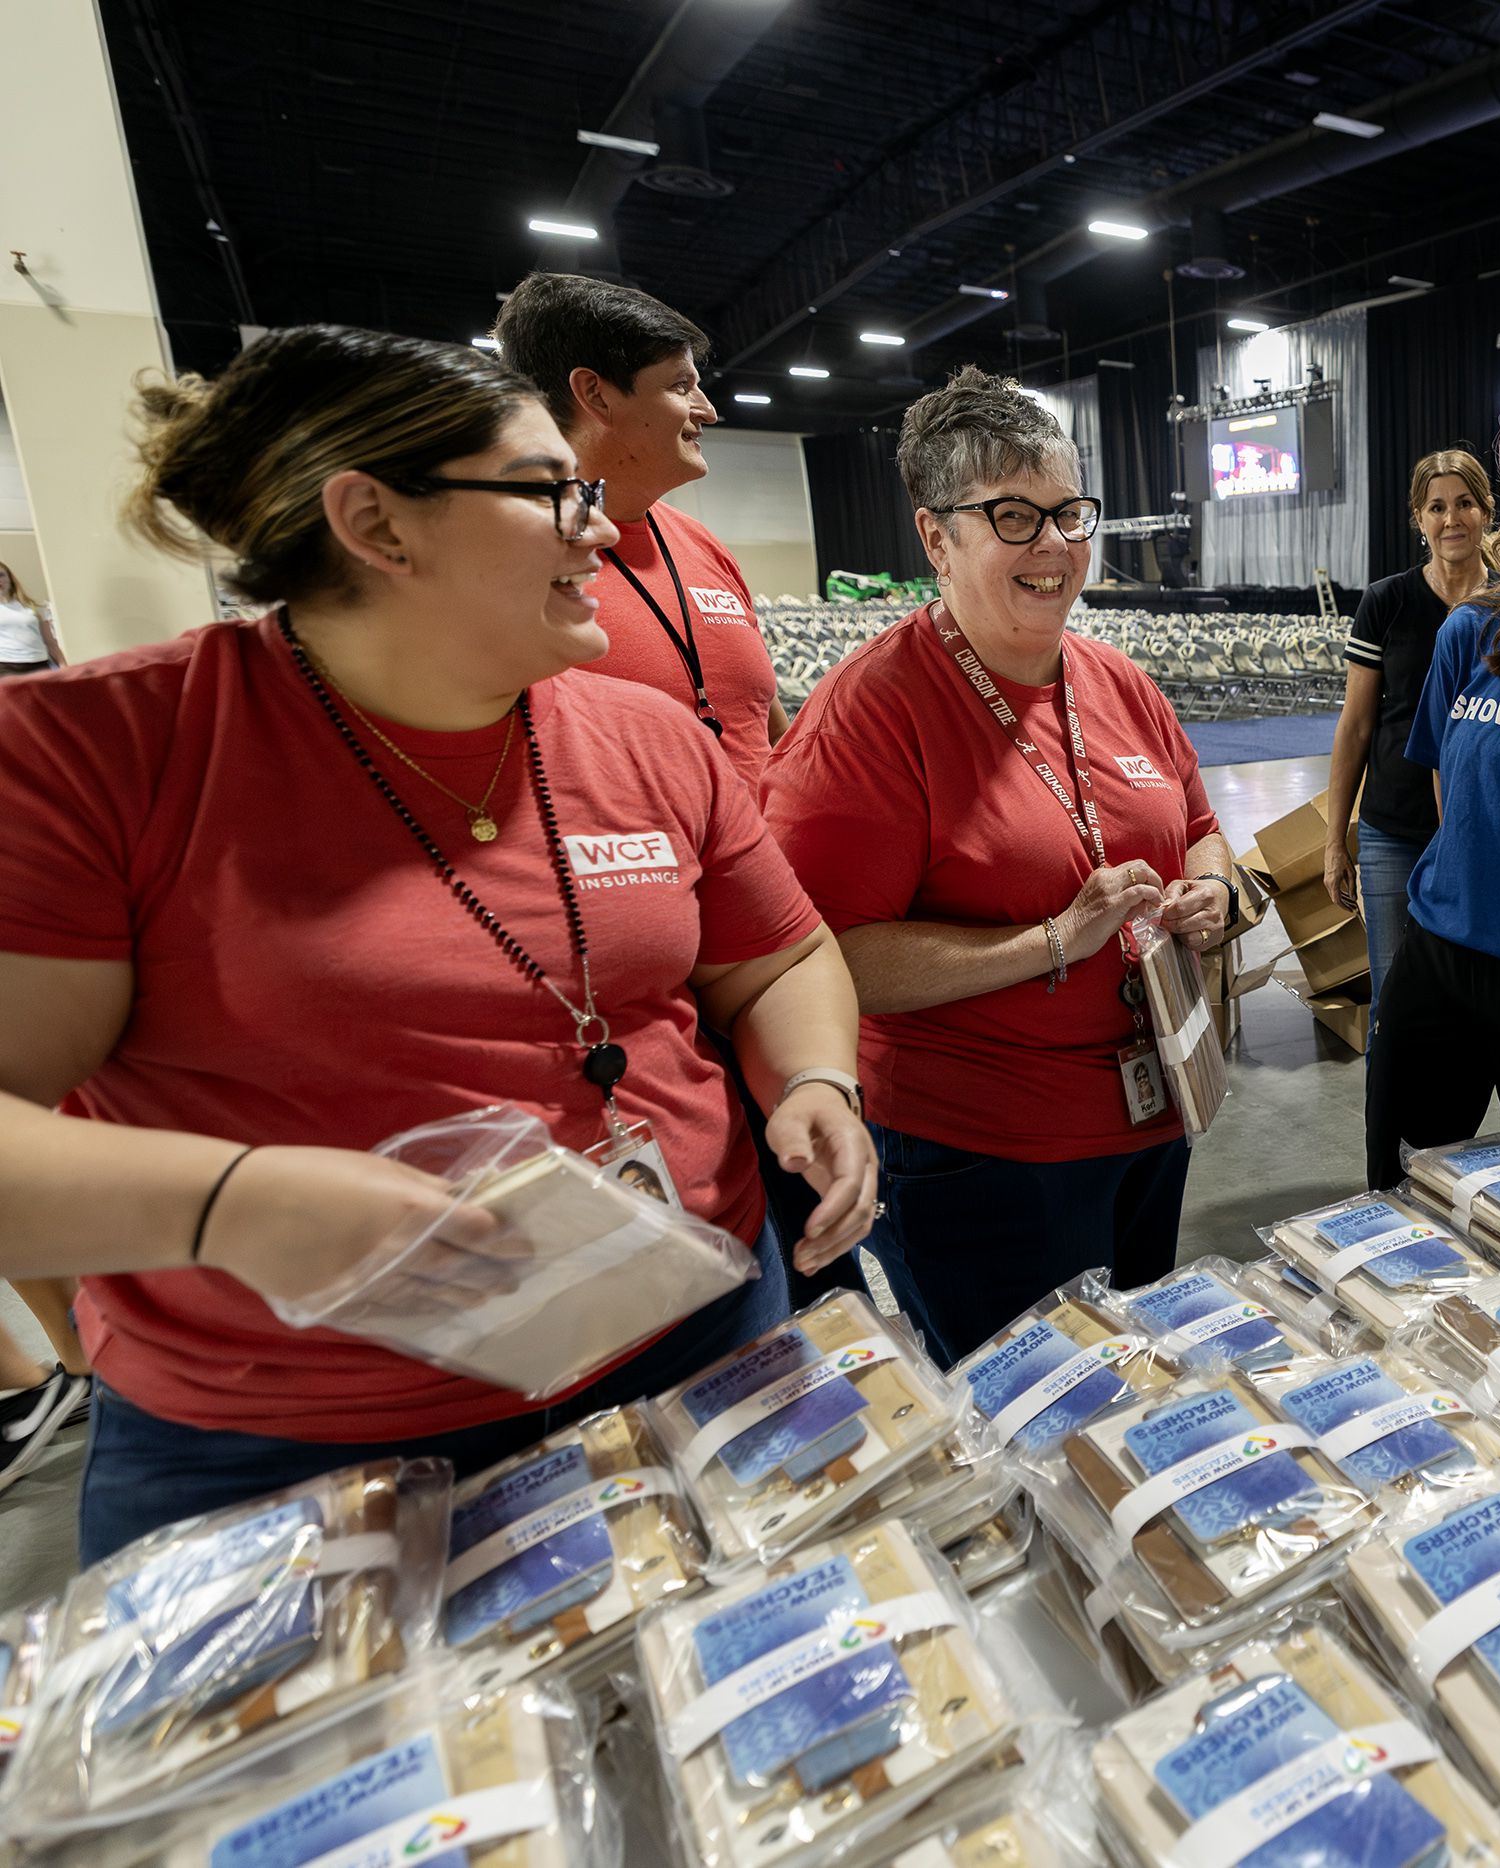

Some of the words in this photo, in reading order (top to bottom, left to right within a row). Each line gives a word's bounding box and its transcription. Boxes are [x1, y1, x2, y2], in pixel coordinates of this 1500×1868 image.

[696, 592, 736, 610] WCF
[703, 616, 751, 628] INSURANC
[955, 648, 998, 699] CRIMSON
[990, 697, 1018, 727] TIDE
[1065, 681, 1077, 709] TIDE
[1069, 711, 1086, 758] CRIMSON
[1036, 763, 1073, 810] CRIMSON
[1083, 799, 1099, 825] TIDE
[577, 838, 661, 866] WCF
[579, 872, 680, 891] INSURANCE
[1324, 1205, 1389, 1229] TEACHERS
[1353, 1219, 1368, 1228] UP
[1367, 1210, 1394, 1222] SHOW
[1364, 1235, 1408, 1253] TEACHERS
[1382, 1244, 1393, 1252] UP
[1393, 1238, 1413, 1248] SHOW
[1136, 1276, 1209, 1309] TEACHERS
[1169, 1293, 1184, 1305] UP
[1184, 1282, 1215, 1298] SHOW
[1189, 1313, 1238, 1336] TEACHERS
[1210, 1325, 1221, 1334] UP
[1222, 1317, 1244, 1329] SHOW
[760, 1340, 804, 1370] SHOW
[967, 1326, 1050, 1385] TEACHERS
[1020, 1331, 1054, 1359] SHOW
[692, 1332, 803, 1400] TEACHERS
[1003, 1356, 1021, 1371] UP
[1077, 1360, 1102, 1378] SHOW
[802, 1370, 836, 1391] SHOW
[1043, 1355, 1098, 1394] TEACHERS
[1063, 1376, 1077, 1389] UP
[1289, 1364, 1377, 1406] TEACHERS
[1347, 1372, 1382, 1393] SHOW
[784, 1388, 802, 1401] UP
[1326, 1388, 1346, 1402] UP
[1133, 1394, 1233, 1441] TEACHERS
[1198, 1404, 1238, 1426] SHOW
[1371, 1403, 1426, 1428] TEACHERS
[1394, 1418, 1407, 1428] UP
[1407, 1410, 1431, 1422] SHOW
[1175, 1421, 1196, 1436] UP
[1172, 1450, 1240, 1487] TEACHERS
[1197, 1471, 1213, 1483] UP
[1213, 1457, 1244, 1476] SHOW
[1462, 1532, 1483, 1548] UP
[704, 1564, 845, 1638] TEACHERS
[789, 1575, 846, 1608] SHOW
[1169, 1686, 1298, 1776] TEACHERS
[1254, 1701, 1306, 1741] SHOW
